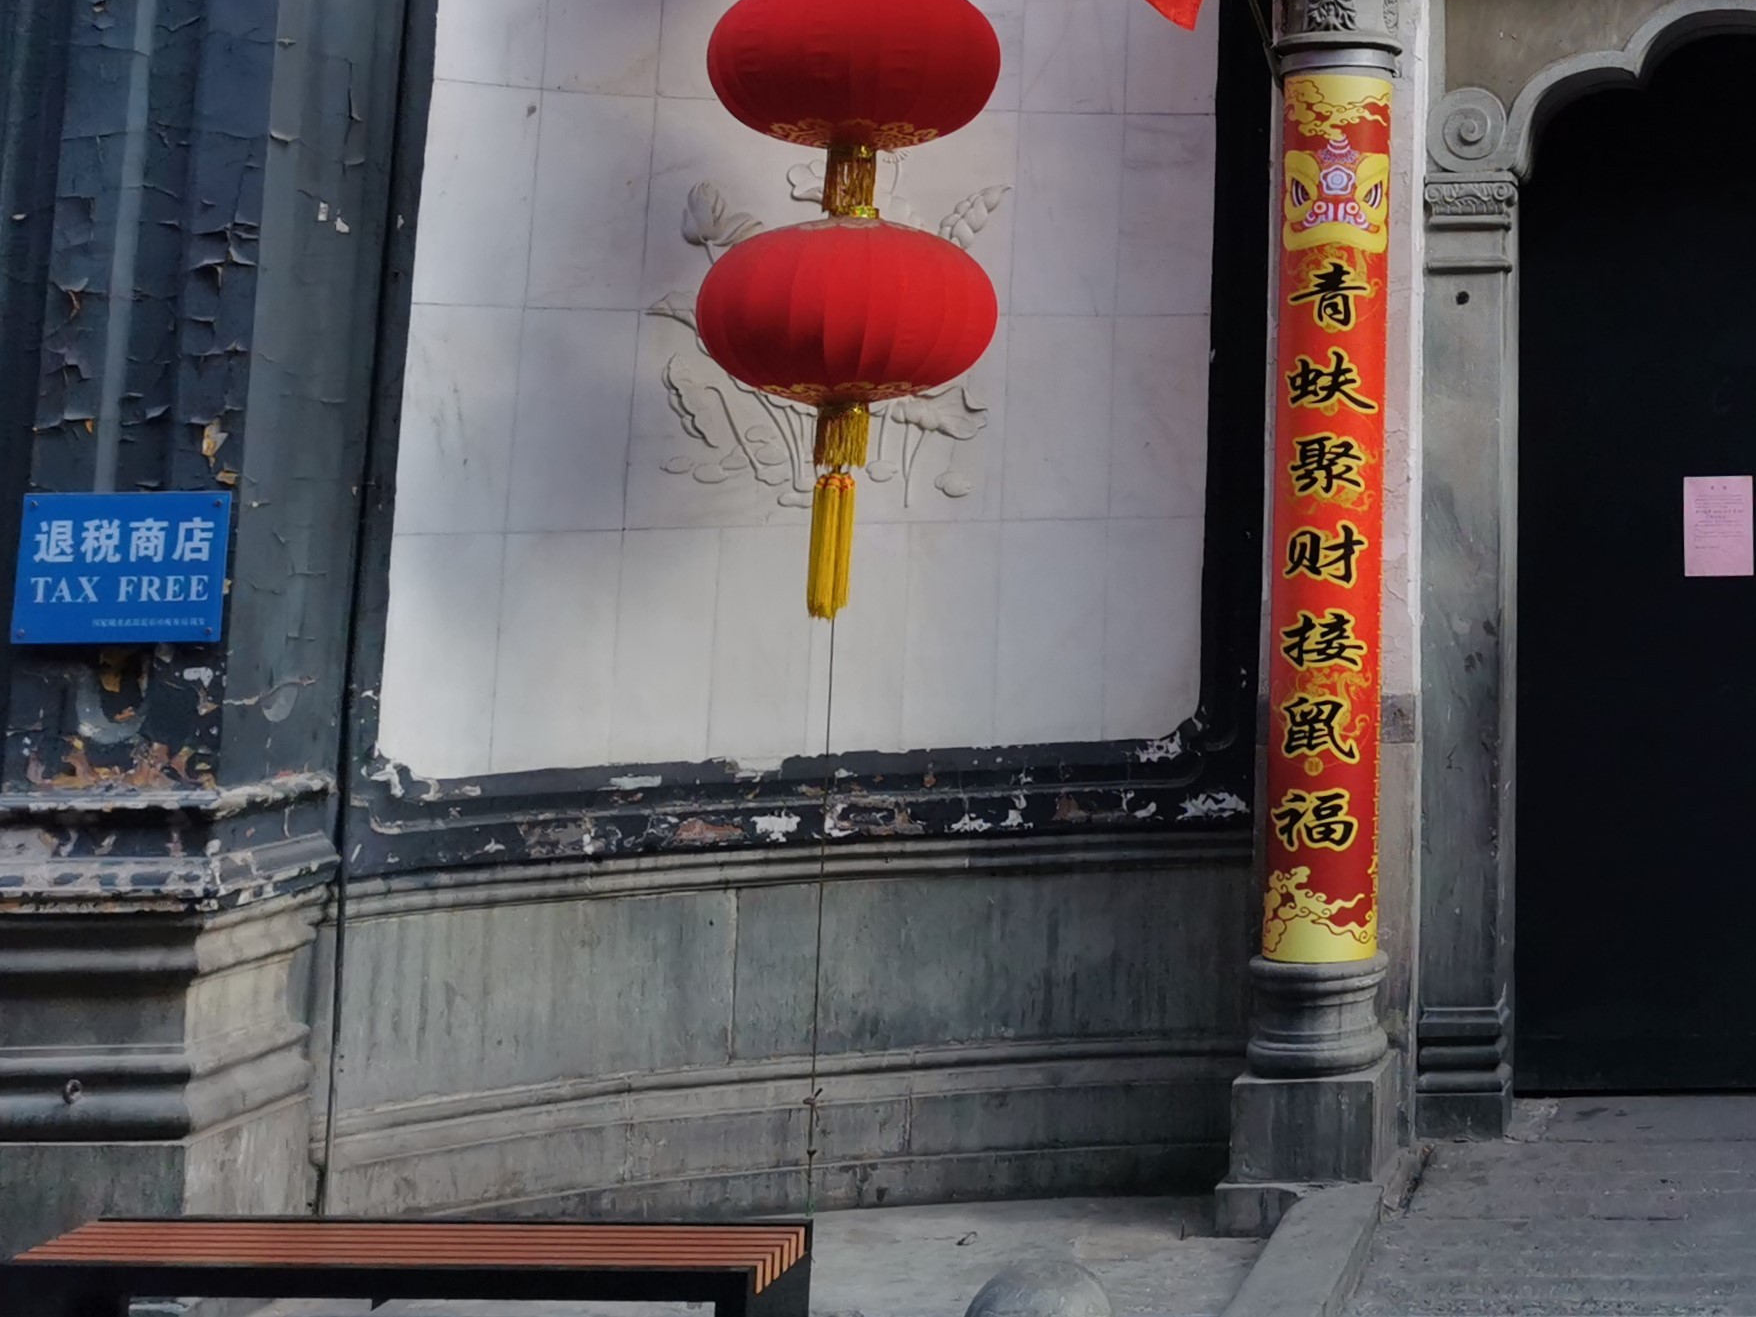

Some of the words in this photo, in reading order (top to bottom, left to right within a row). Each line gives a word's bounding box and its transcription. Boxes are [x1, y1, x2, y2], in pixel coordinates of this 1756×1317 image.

[33, 516, 215, 564] 退税商店
[1272, 262, 1376, 848] 青蚨聚财接鼠福
[31, 576, 99, 603] TAX
[117, 575, 209, 603] FREE
